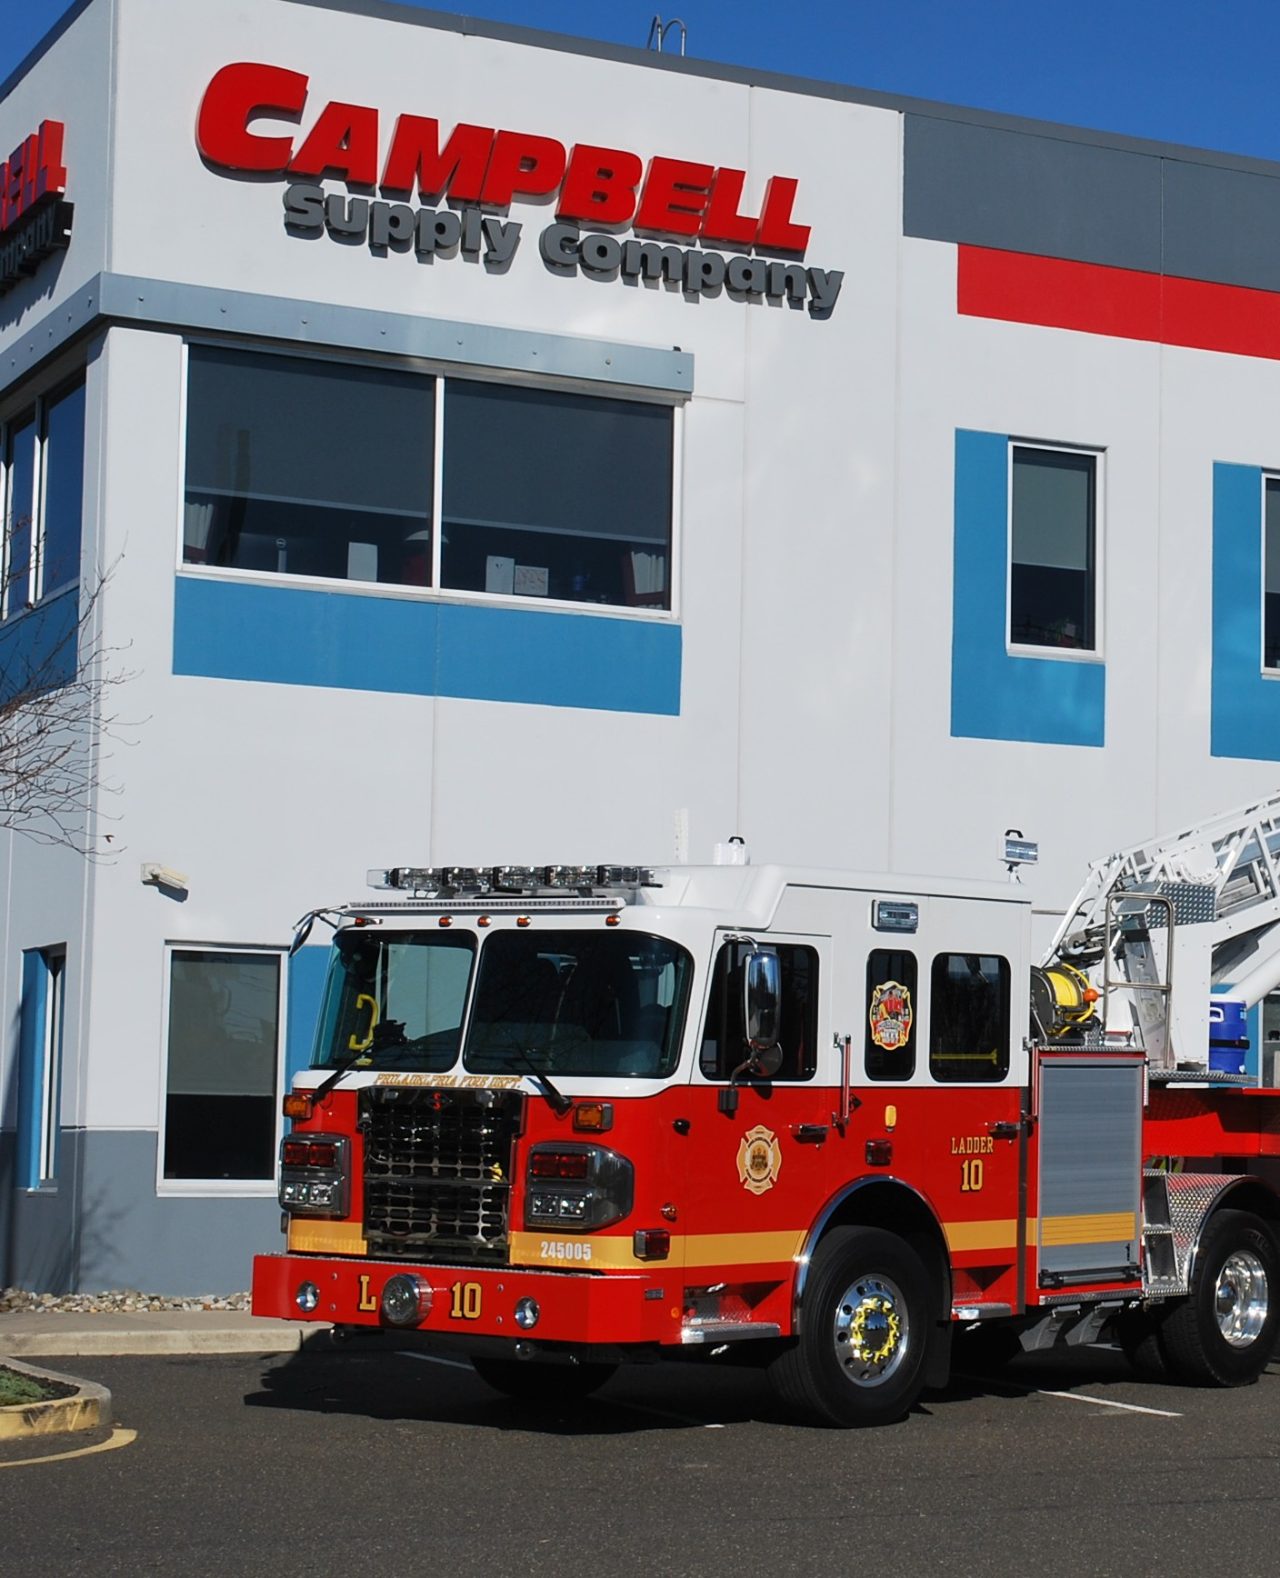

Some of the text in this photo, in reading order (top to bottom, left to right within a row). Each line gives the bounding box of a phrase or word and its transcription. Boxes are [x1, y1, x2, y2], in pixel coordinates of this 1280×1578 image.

[195, 62, 813, 256] CAMPBELL
[282, 184, 845, 314] Supply Company
[951, 1136, 994, 1155] LADDER
[961, 1159, 984, 1191] 10
[540, 1240, 592, 1261] 245005
[1125, 1243, 1131, 1262] 1
[358, 1275, 483, 1319] L 10
